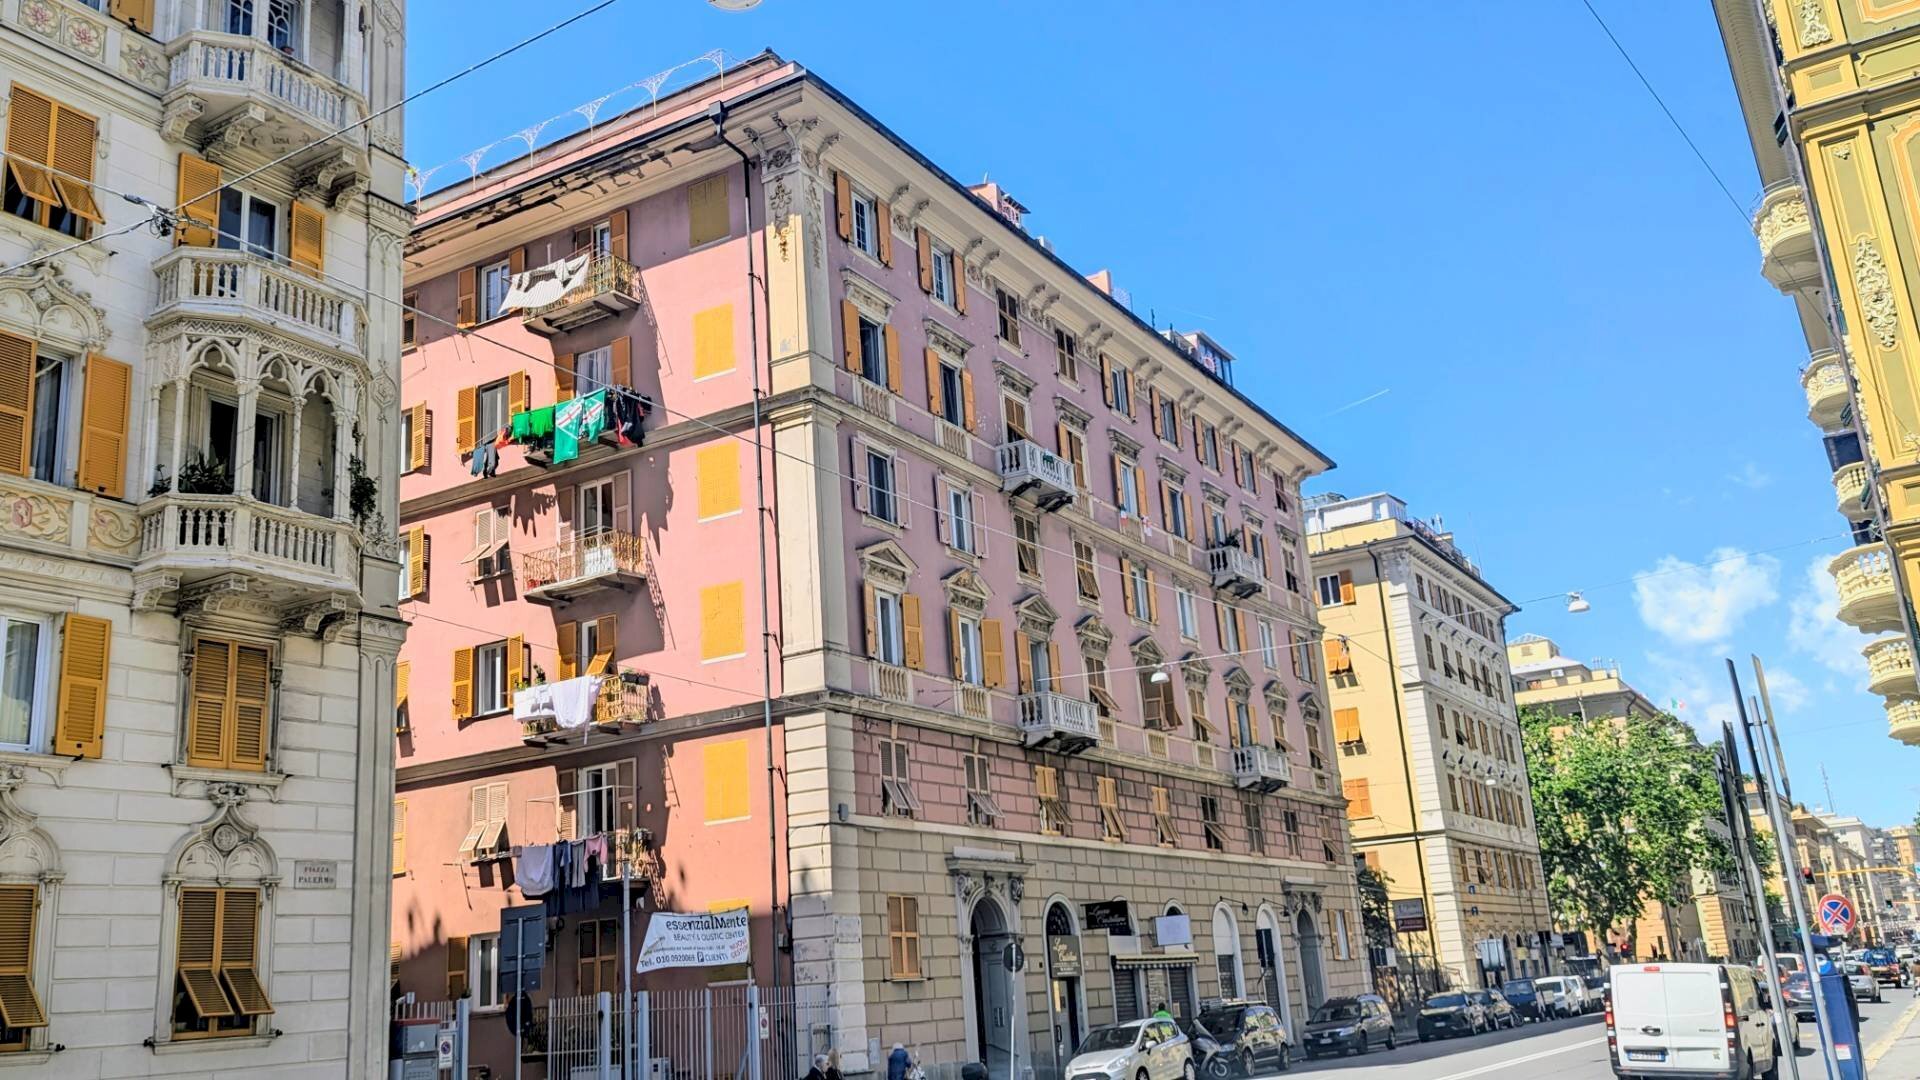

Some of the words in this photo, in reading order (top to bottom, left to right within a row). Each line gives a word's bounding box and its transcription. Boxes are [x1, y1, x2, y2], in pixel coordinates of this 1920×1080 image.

[298, 876, 334, 884] PALERMO
[666, 916, 746, 930] essenzialMente
[673, 933, 695, 941] BEAUTY
[725, 930, 745, 940] CENTER
[705, 952, 729, 961] CLIENTI
[640, 958, 655, 968] Tel.
